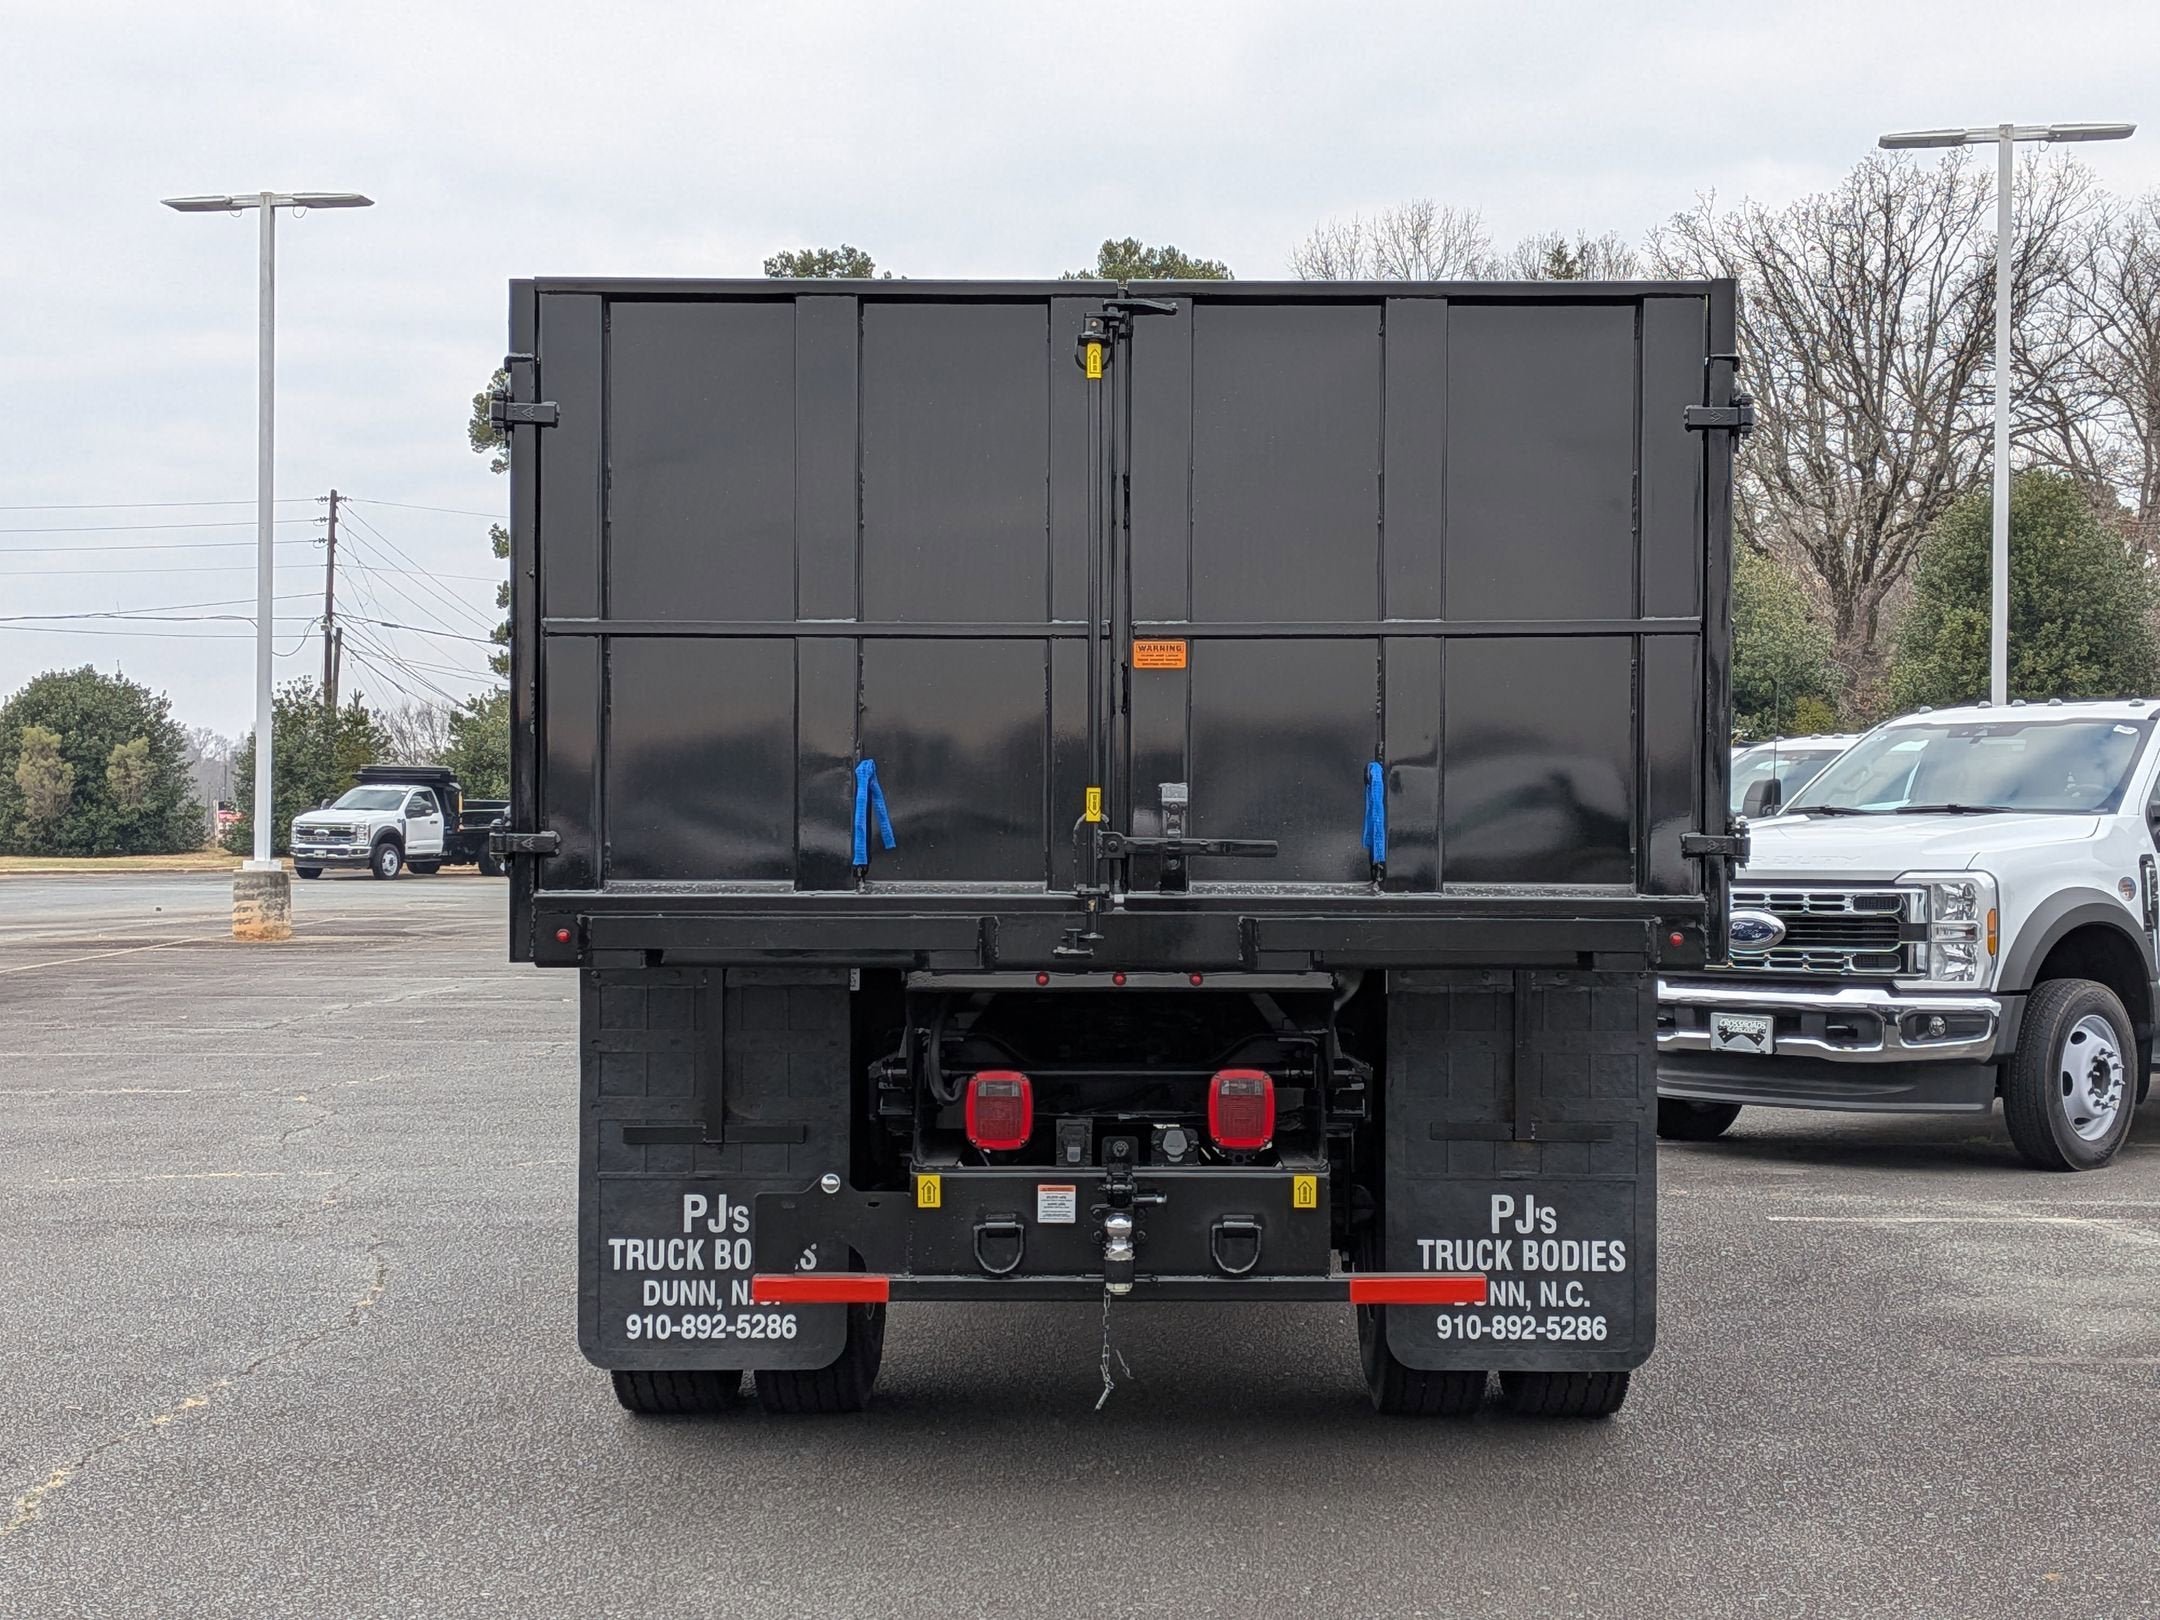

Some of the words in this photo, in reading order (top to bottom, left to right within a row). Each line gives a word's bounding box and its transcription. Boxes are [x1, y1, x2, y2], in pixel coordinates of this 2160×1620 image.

[1720, 1018, 1767, 1030] CROSSROADS
[683, 1194, 750, 1234] PJ's
[1491, 1194, 1558, 1235] PJ's
[608, 1238, 705, 1271] TRUCK
[714, 1238, 818, 1271] BOS
[1416, 1239, 1514, 1272] TRUCK
[1522, 1240, 1627, 1273] BODIES
[643, 1279, 723, 1312] DUNN,
[1453, 1280, 1532, 1312] NN,
[1540, 1280, 1592, 1308] N.C.
[625, 1313, 798, 1340] 910-892-5286
[1436, 1314, 1608, 1341] 910-892-5286
